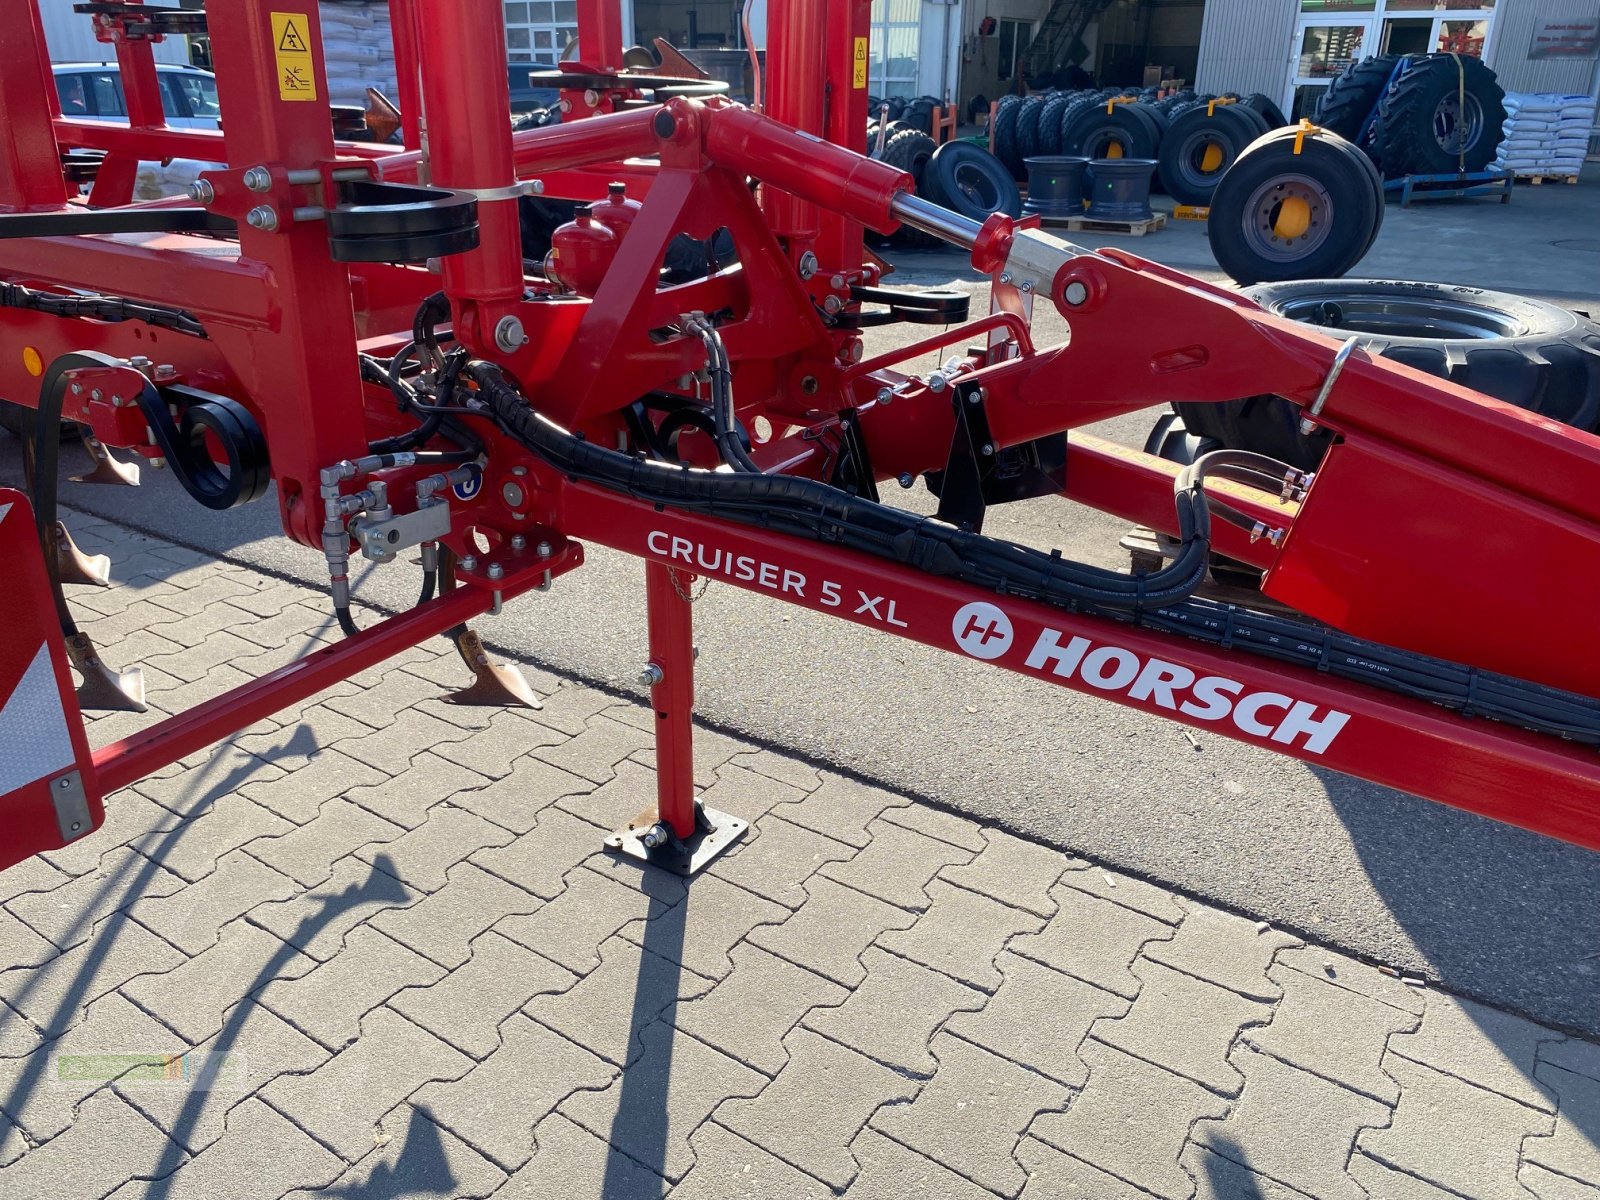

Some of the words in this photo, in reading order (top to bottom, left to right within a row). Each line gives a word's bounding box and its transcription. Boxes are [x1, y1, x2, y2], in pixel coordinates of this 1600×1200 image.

[647, 530, 807, 598] CRUISER
[819, 580, 842, 607] 5
[853, 589, 908, 628] XL
[1023, 627, 1352, 755] HORSCH
